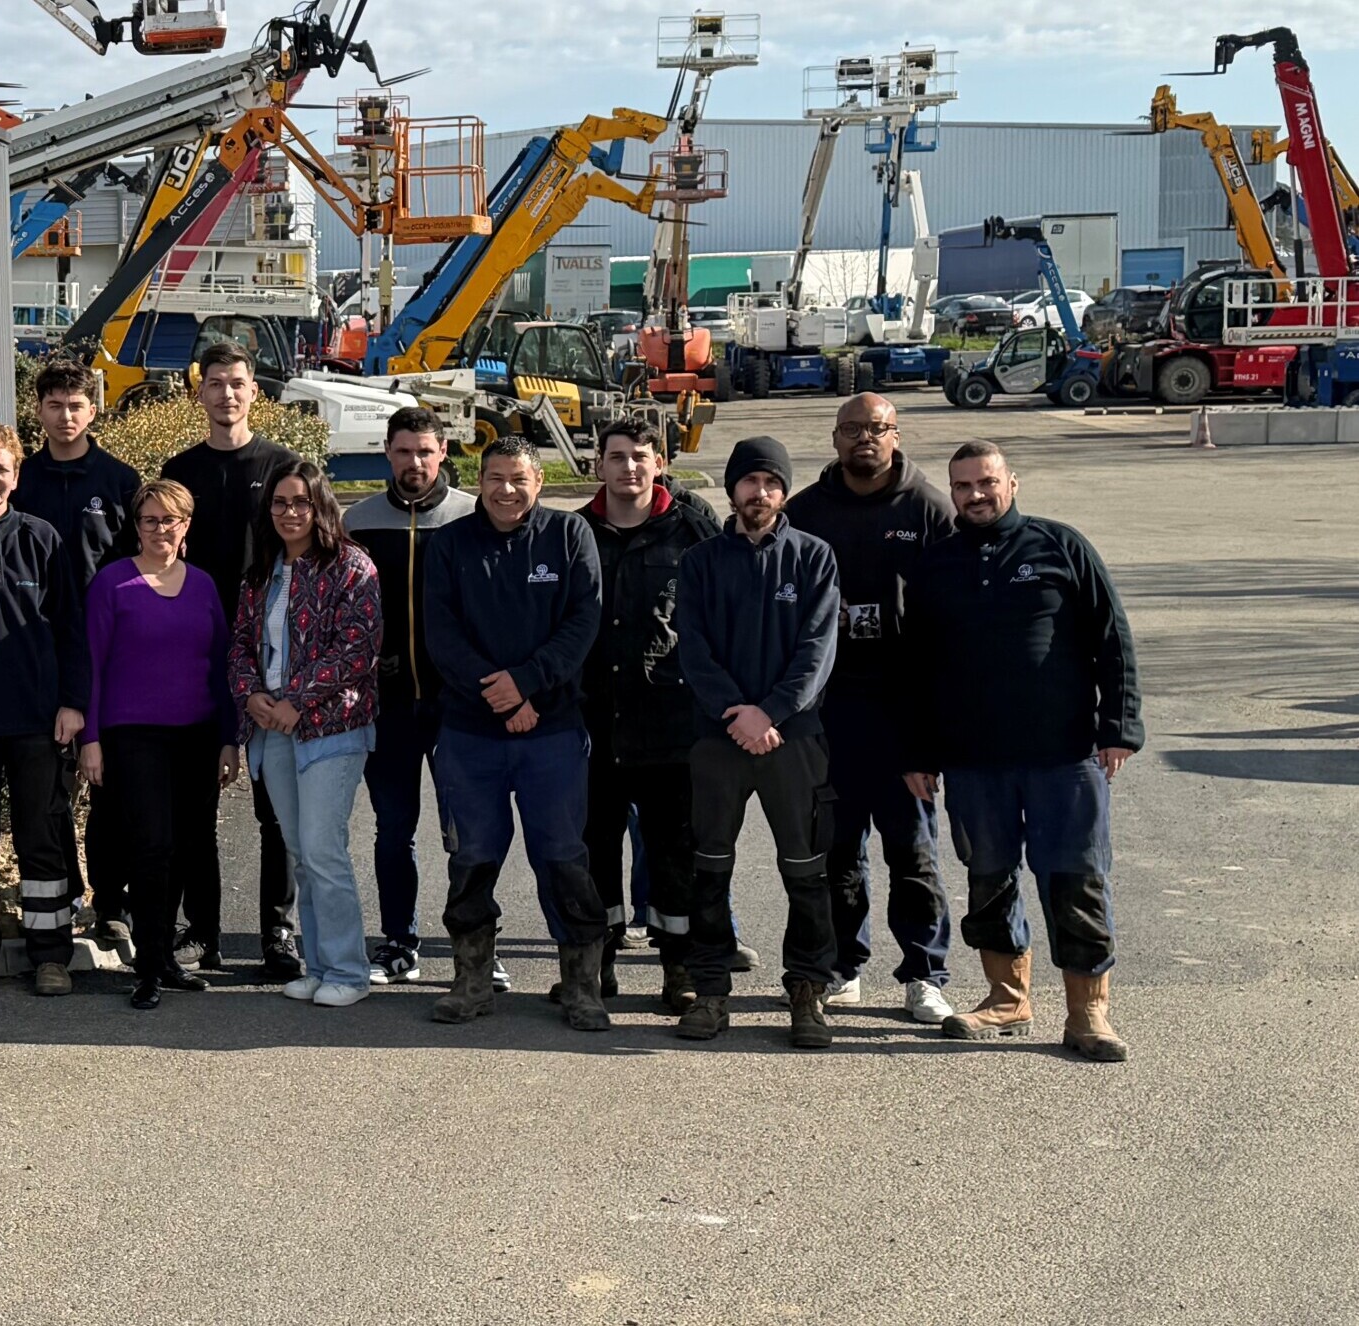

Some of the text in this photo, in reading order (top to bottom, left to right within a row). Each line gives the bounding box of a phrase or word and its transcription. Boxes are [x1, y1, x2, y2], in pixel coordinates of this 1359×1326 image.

[1295, 103, 1316, 149] MAGNI
[1227, 159, 1243, 188] JCB
[896, 530, 918, 540] OAK
